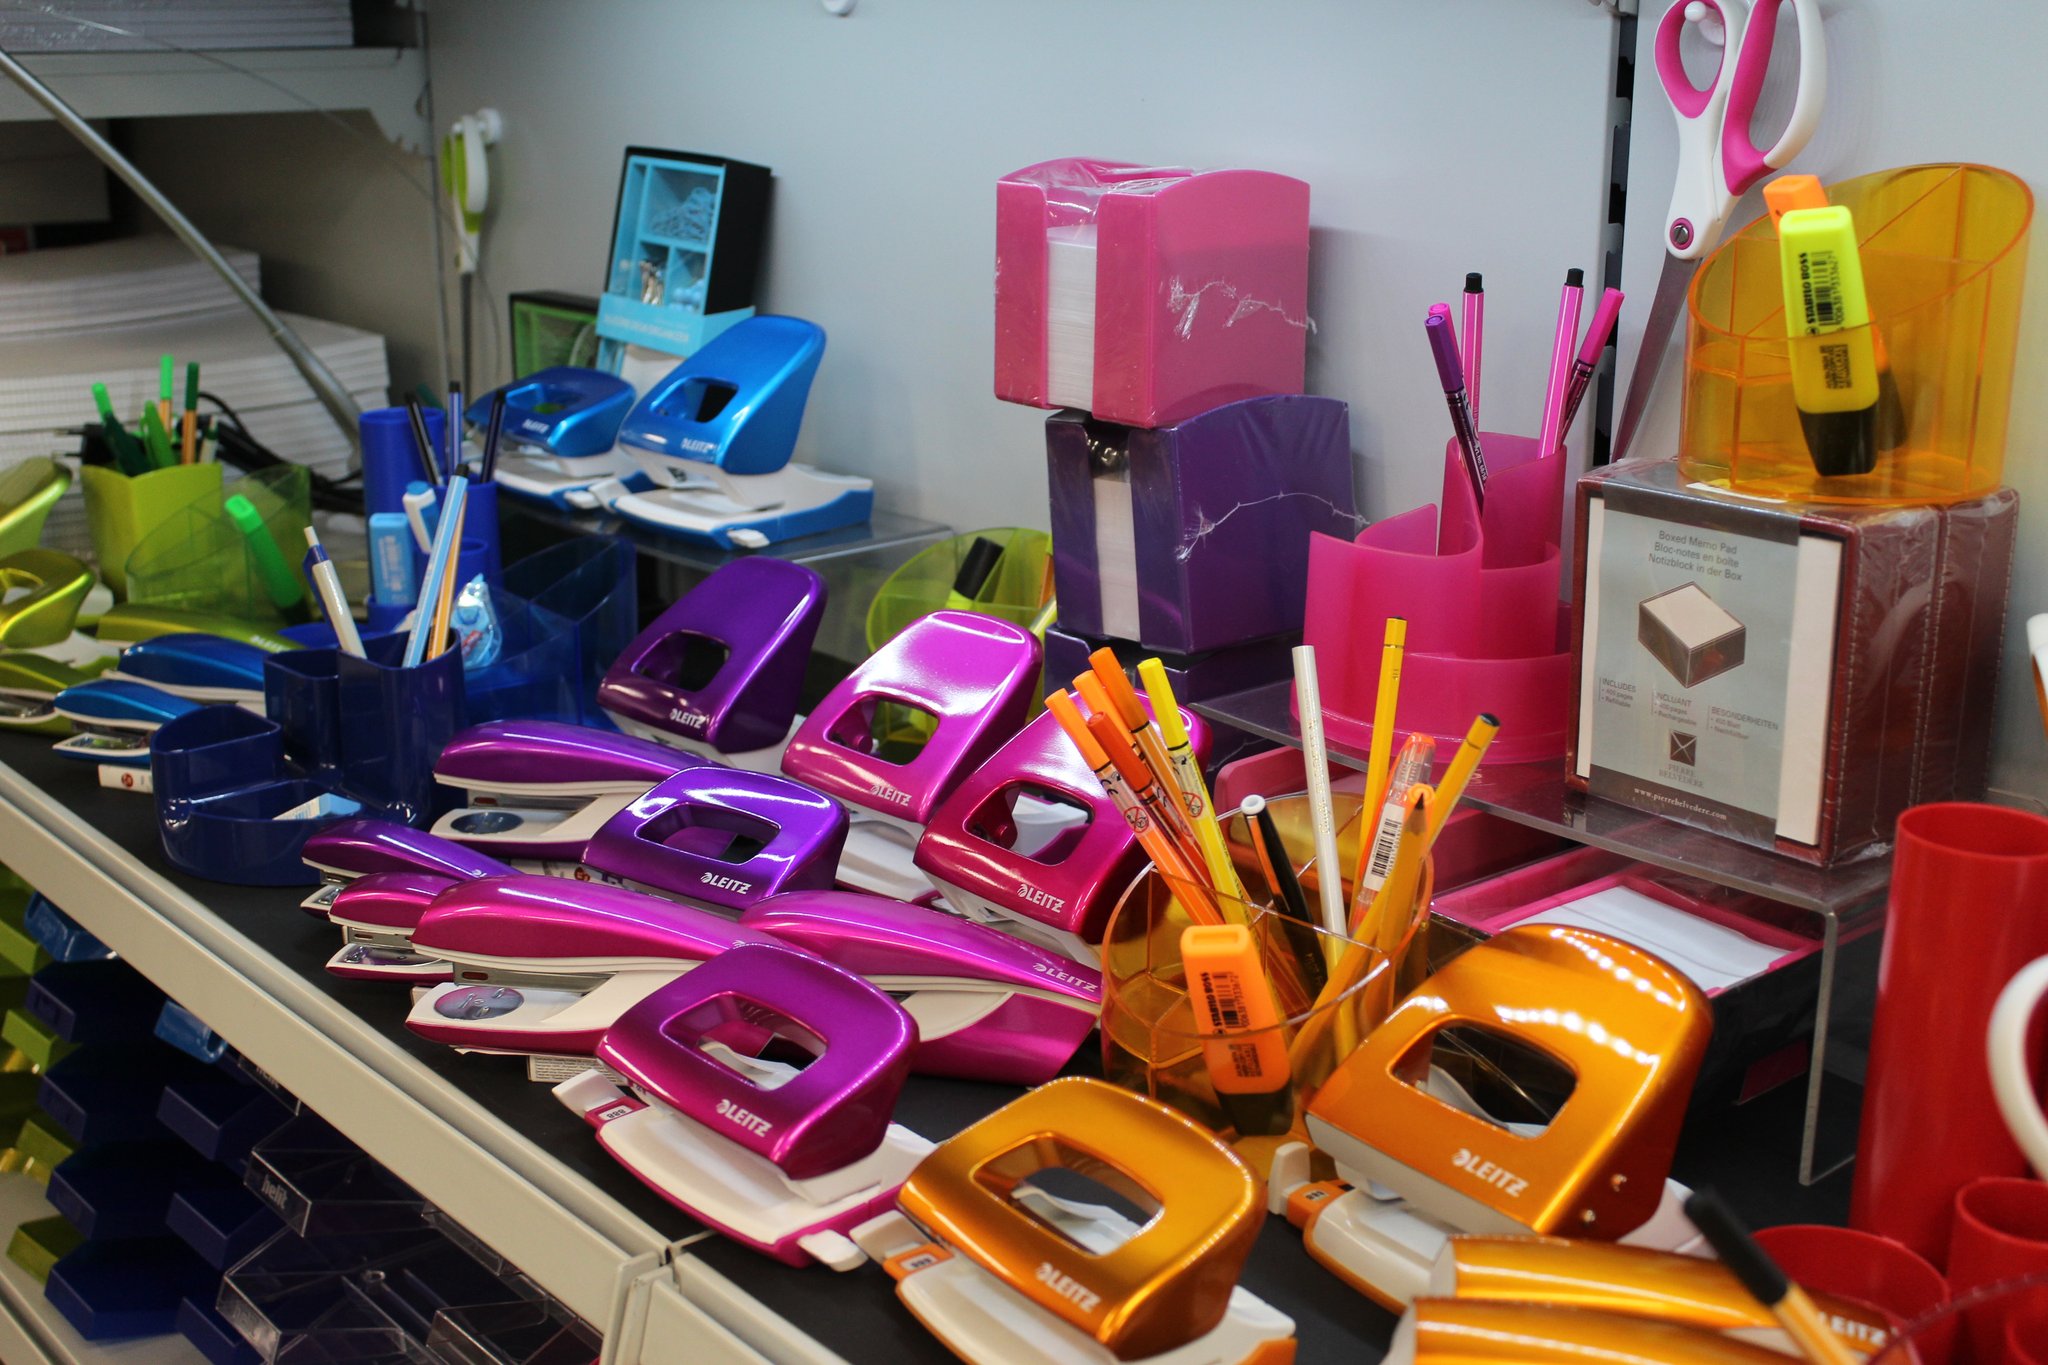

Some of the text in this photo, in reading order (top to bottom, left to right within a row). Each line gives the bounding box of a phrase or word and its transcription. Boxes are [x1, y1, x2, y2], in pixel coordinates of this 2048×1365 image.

[1798, 252, 1816, 324] STABILO BOSS
[1654, 541, 1701, 560] Bloc-notes
[1702, 553, 1714, 562] en
[1659, 530, 1738, 555] Boxed Memo Pad
[1648, 553, 1743, 581] Notizblock in der Box
[1602, 677, 1637, 693] INCLUDES
[677, 710, 706, 729] LEITZ
[877, 785, 913, 807] LEITZ
[1634, 787, 1728, 821] www.pierrebelvedere.com
[709, 874, 752, 895] LEITZ
[1025, 887, 1066, 913] LEITZ
[1046, 968, 1098, 992] LEITZ
[724, 1104, 773, 1138] LEITZ
[1464, 1155, 1528, 1198] LEITZ
[261, 1174, 288, 1210] helit
[1046, 1269, 1101, 1313] LEITZ
